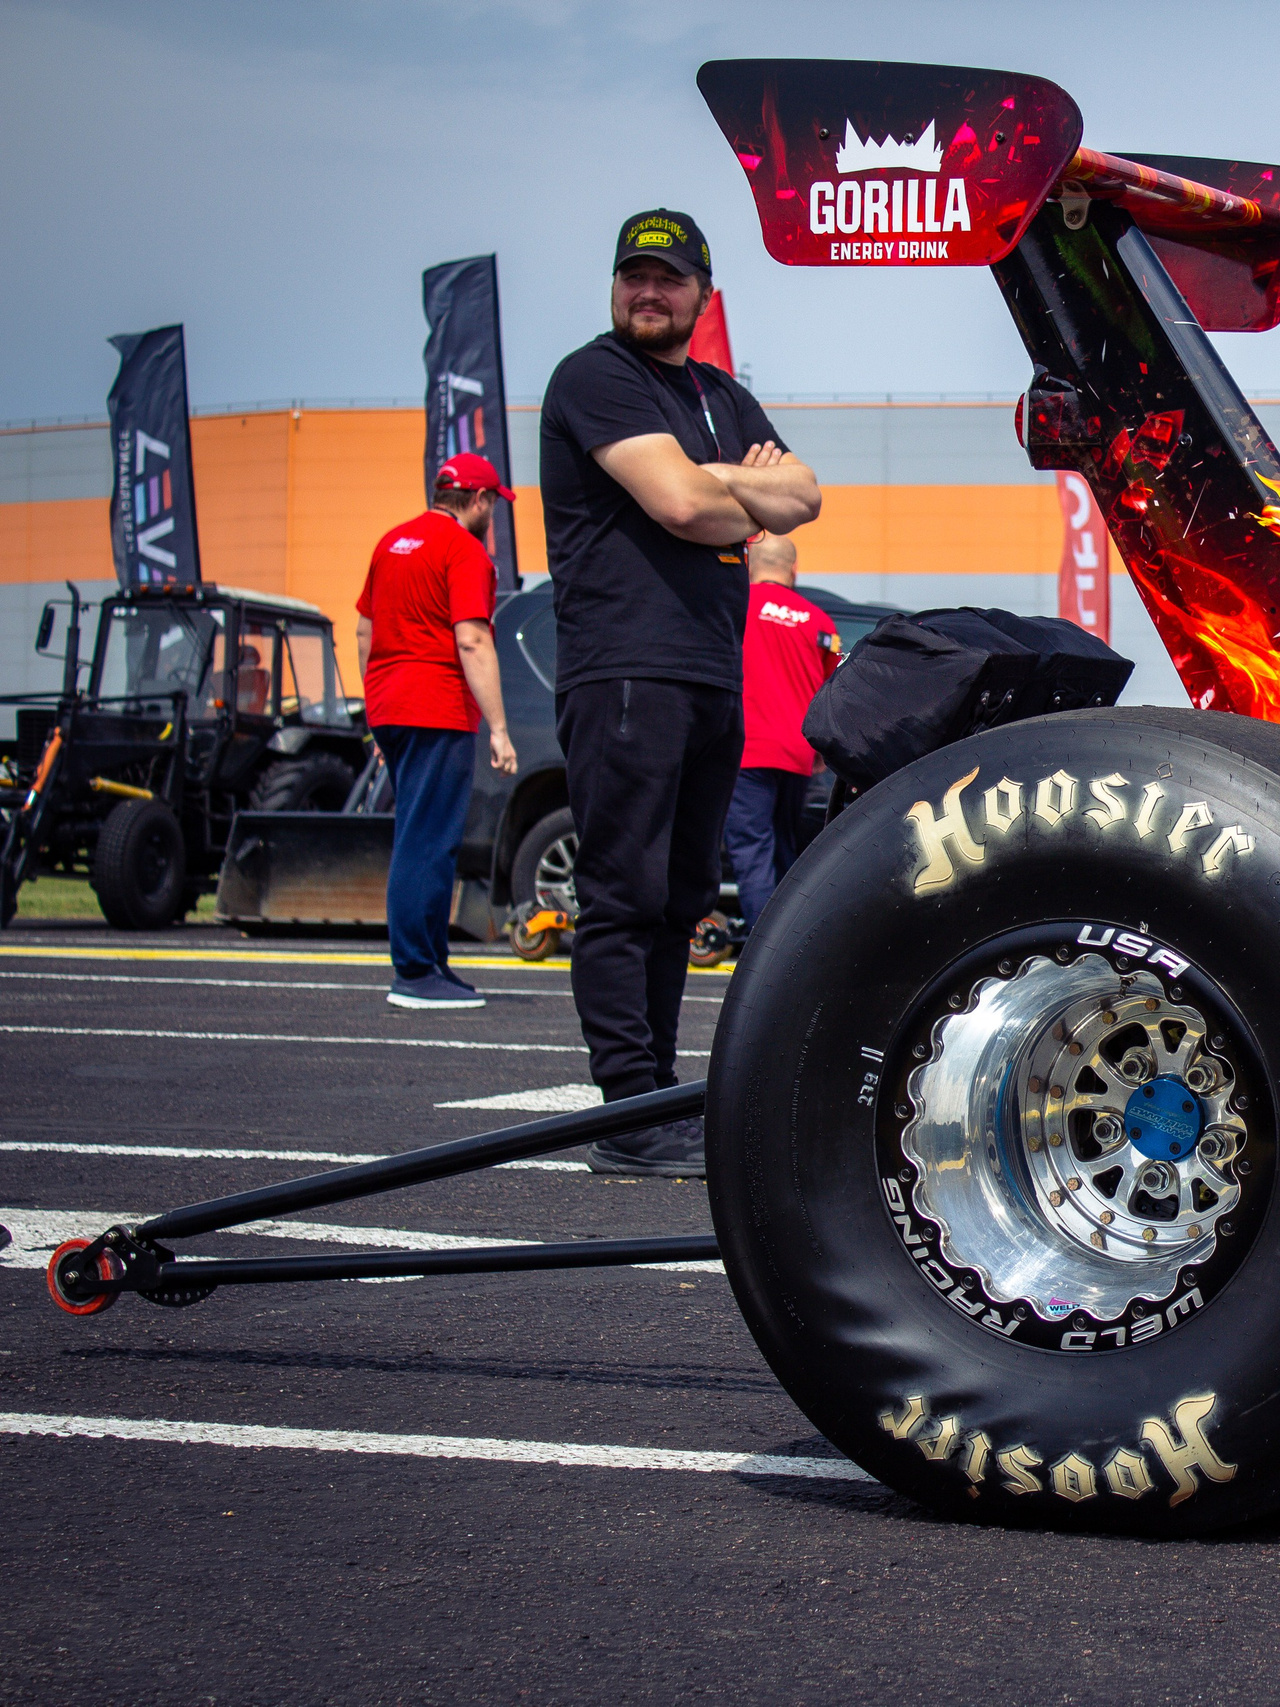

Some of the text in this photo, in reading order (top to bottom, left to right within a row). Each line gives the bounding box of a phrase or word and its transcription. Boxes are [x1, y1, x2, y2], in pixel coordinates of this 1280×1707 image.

[809, 178, 972, 235] GORILLA
[637, 233, 669, 245] HOCKEY
[830, 241, 949, 260] ENERGY DRINK
[905, 763, 1252, 893] Hoosier
[1077, 924, 1191, 979] USA
[882, 1177, 1021, 1337] RACING
[1061, 1287, 1204, 1351] WELD
[880, 1394, 1238, 1508] Hoosier
